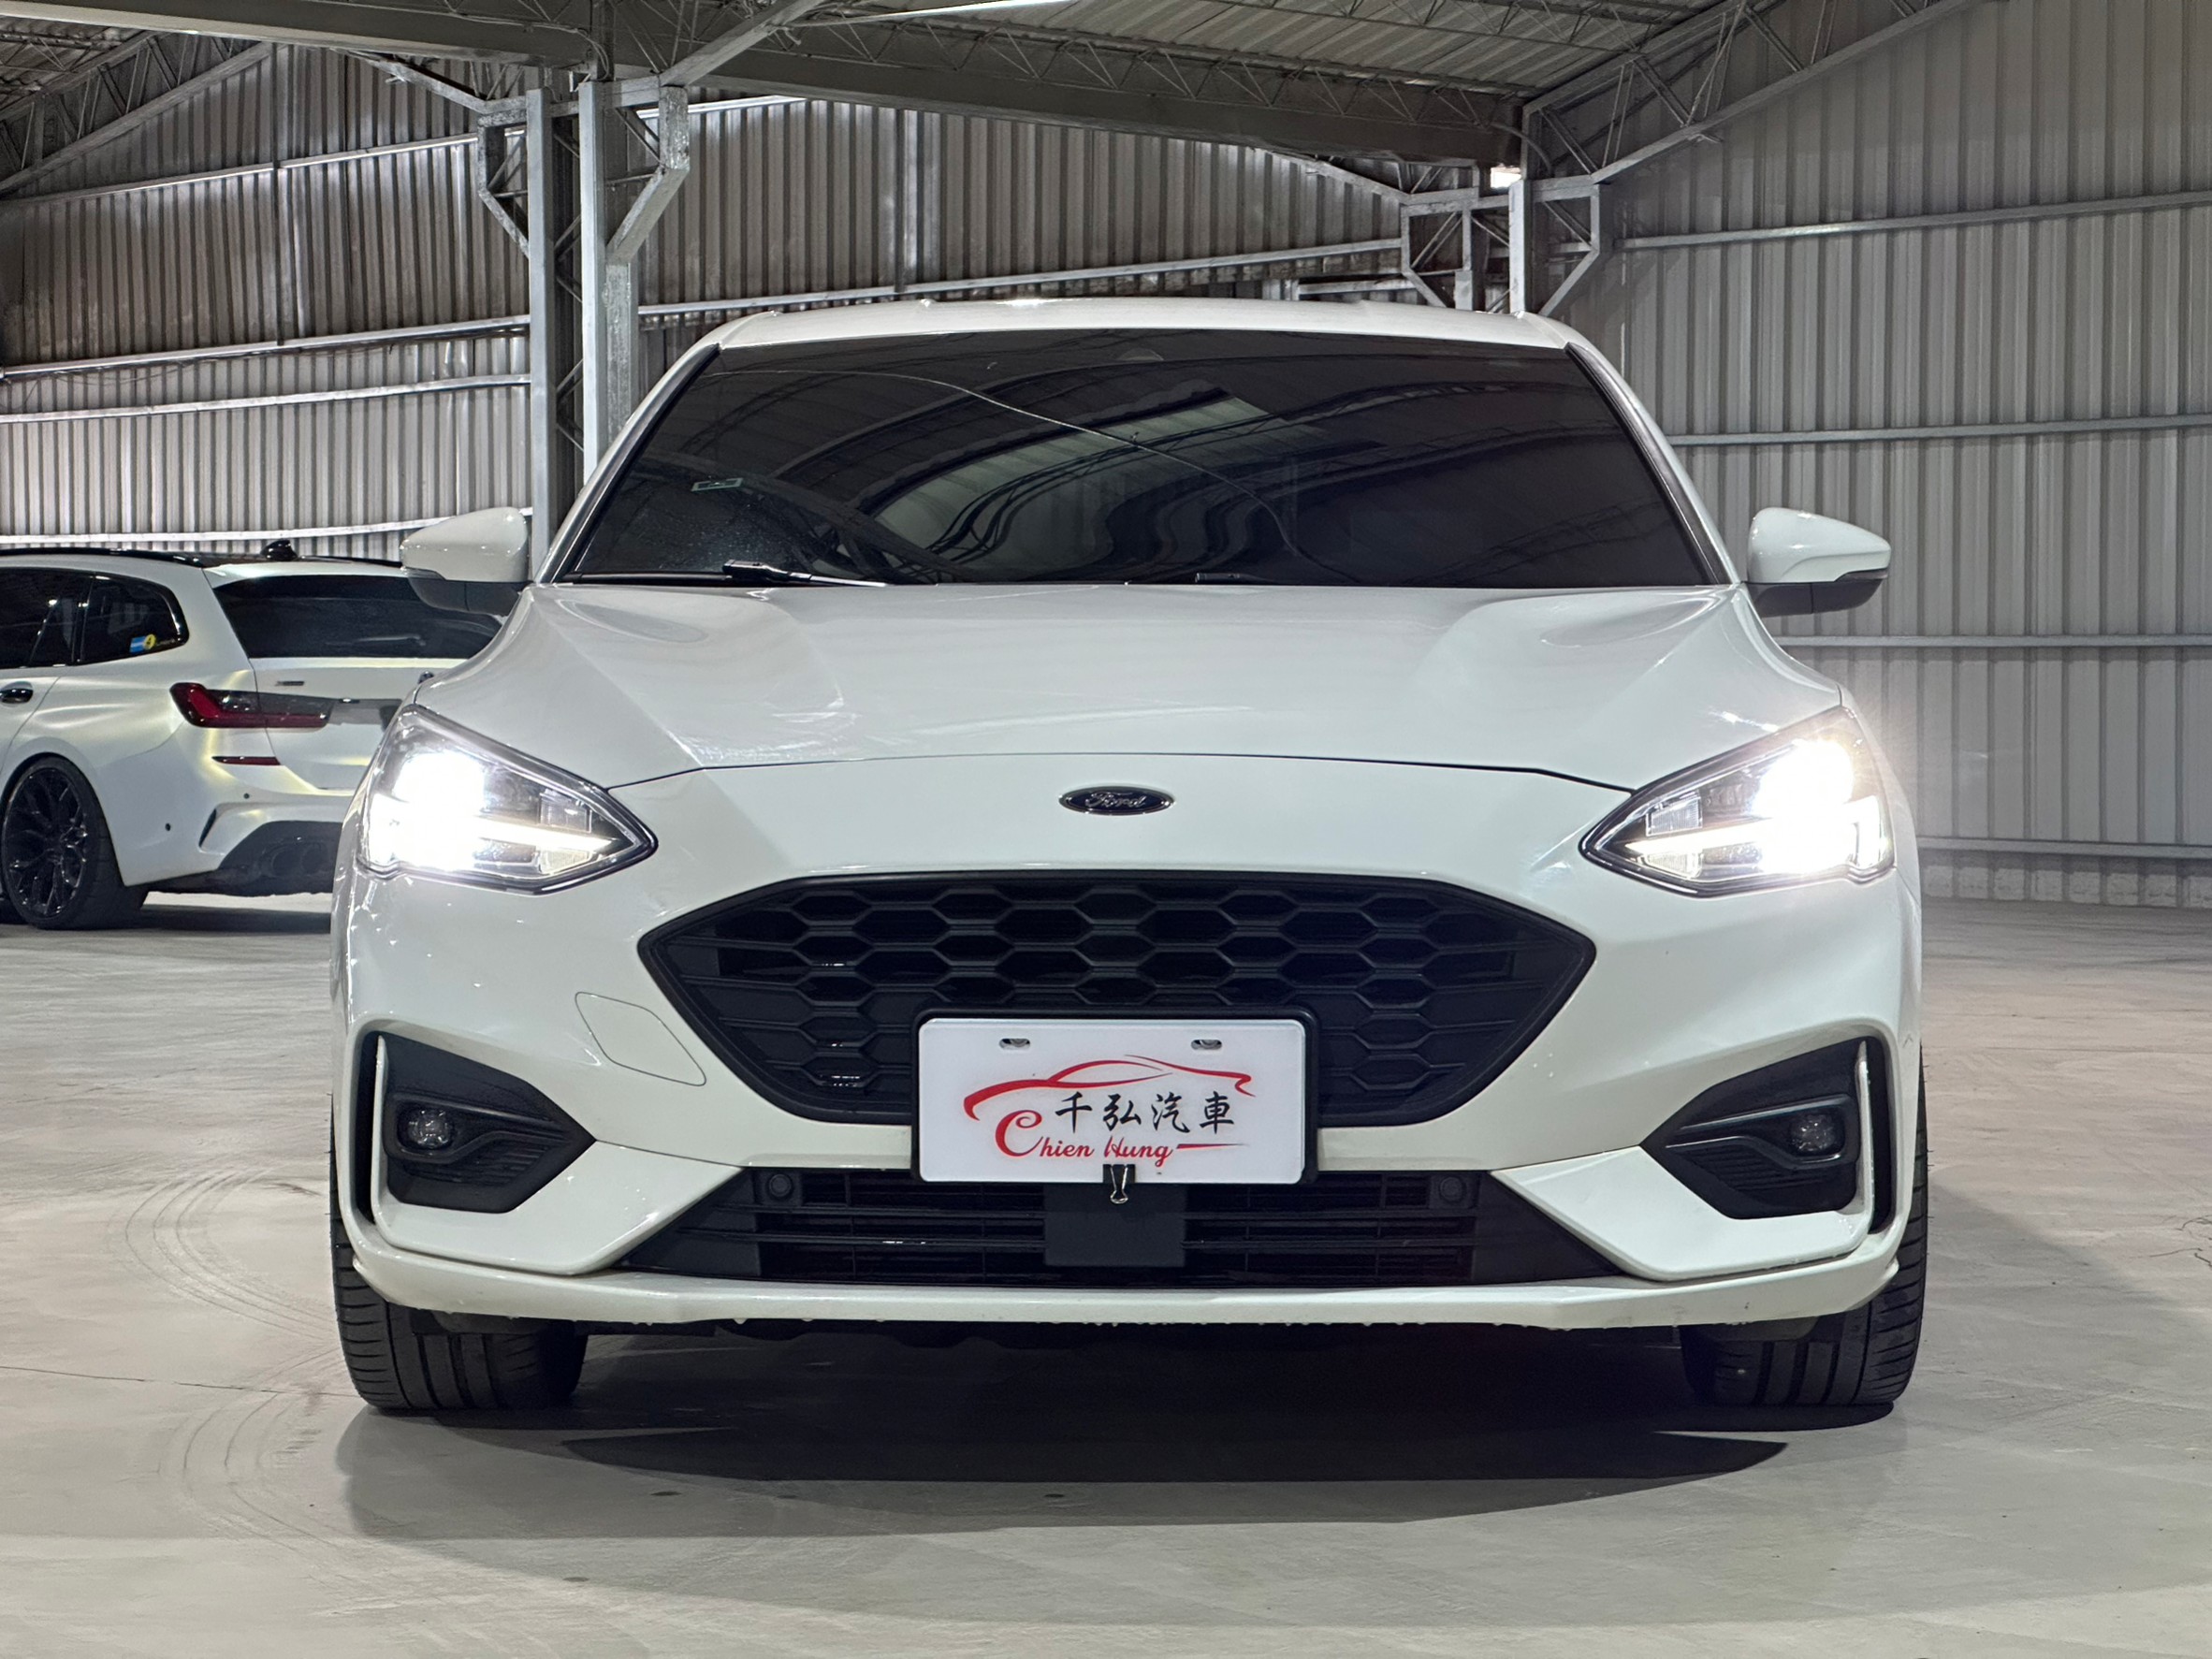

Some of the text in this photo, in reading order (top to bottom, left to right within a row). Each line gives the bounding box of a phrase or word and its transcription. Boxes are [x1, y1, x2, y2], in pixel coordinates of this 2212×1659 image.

[1055, 1091, 1235, 1134] 千弘汽車
[995, 1110, 1174, 1168] Chien Hung
